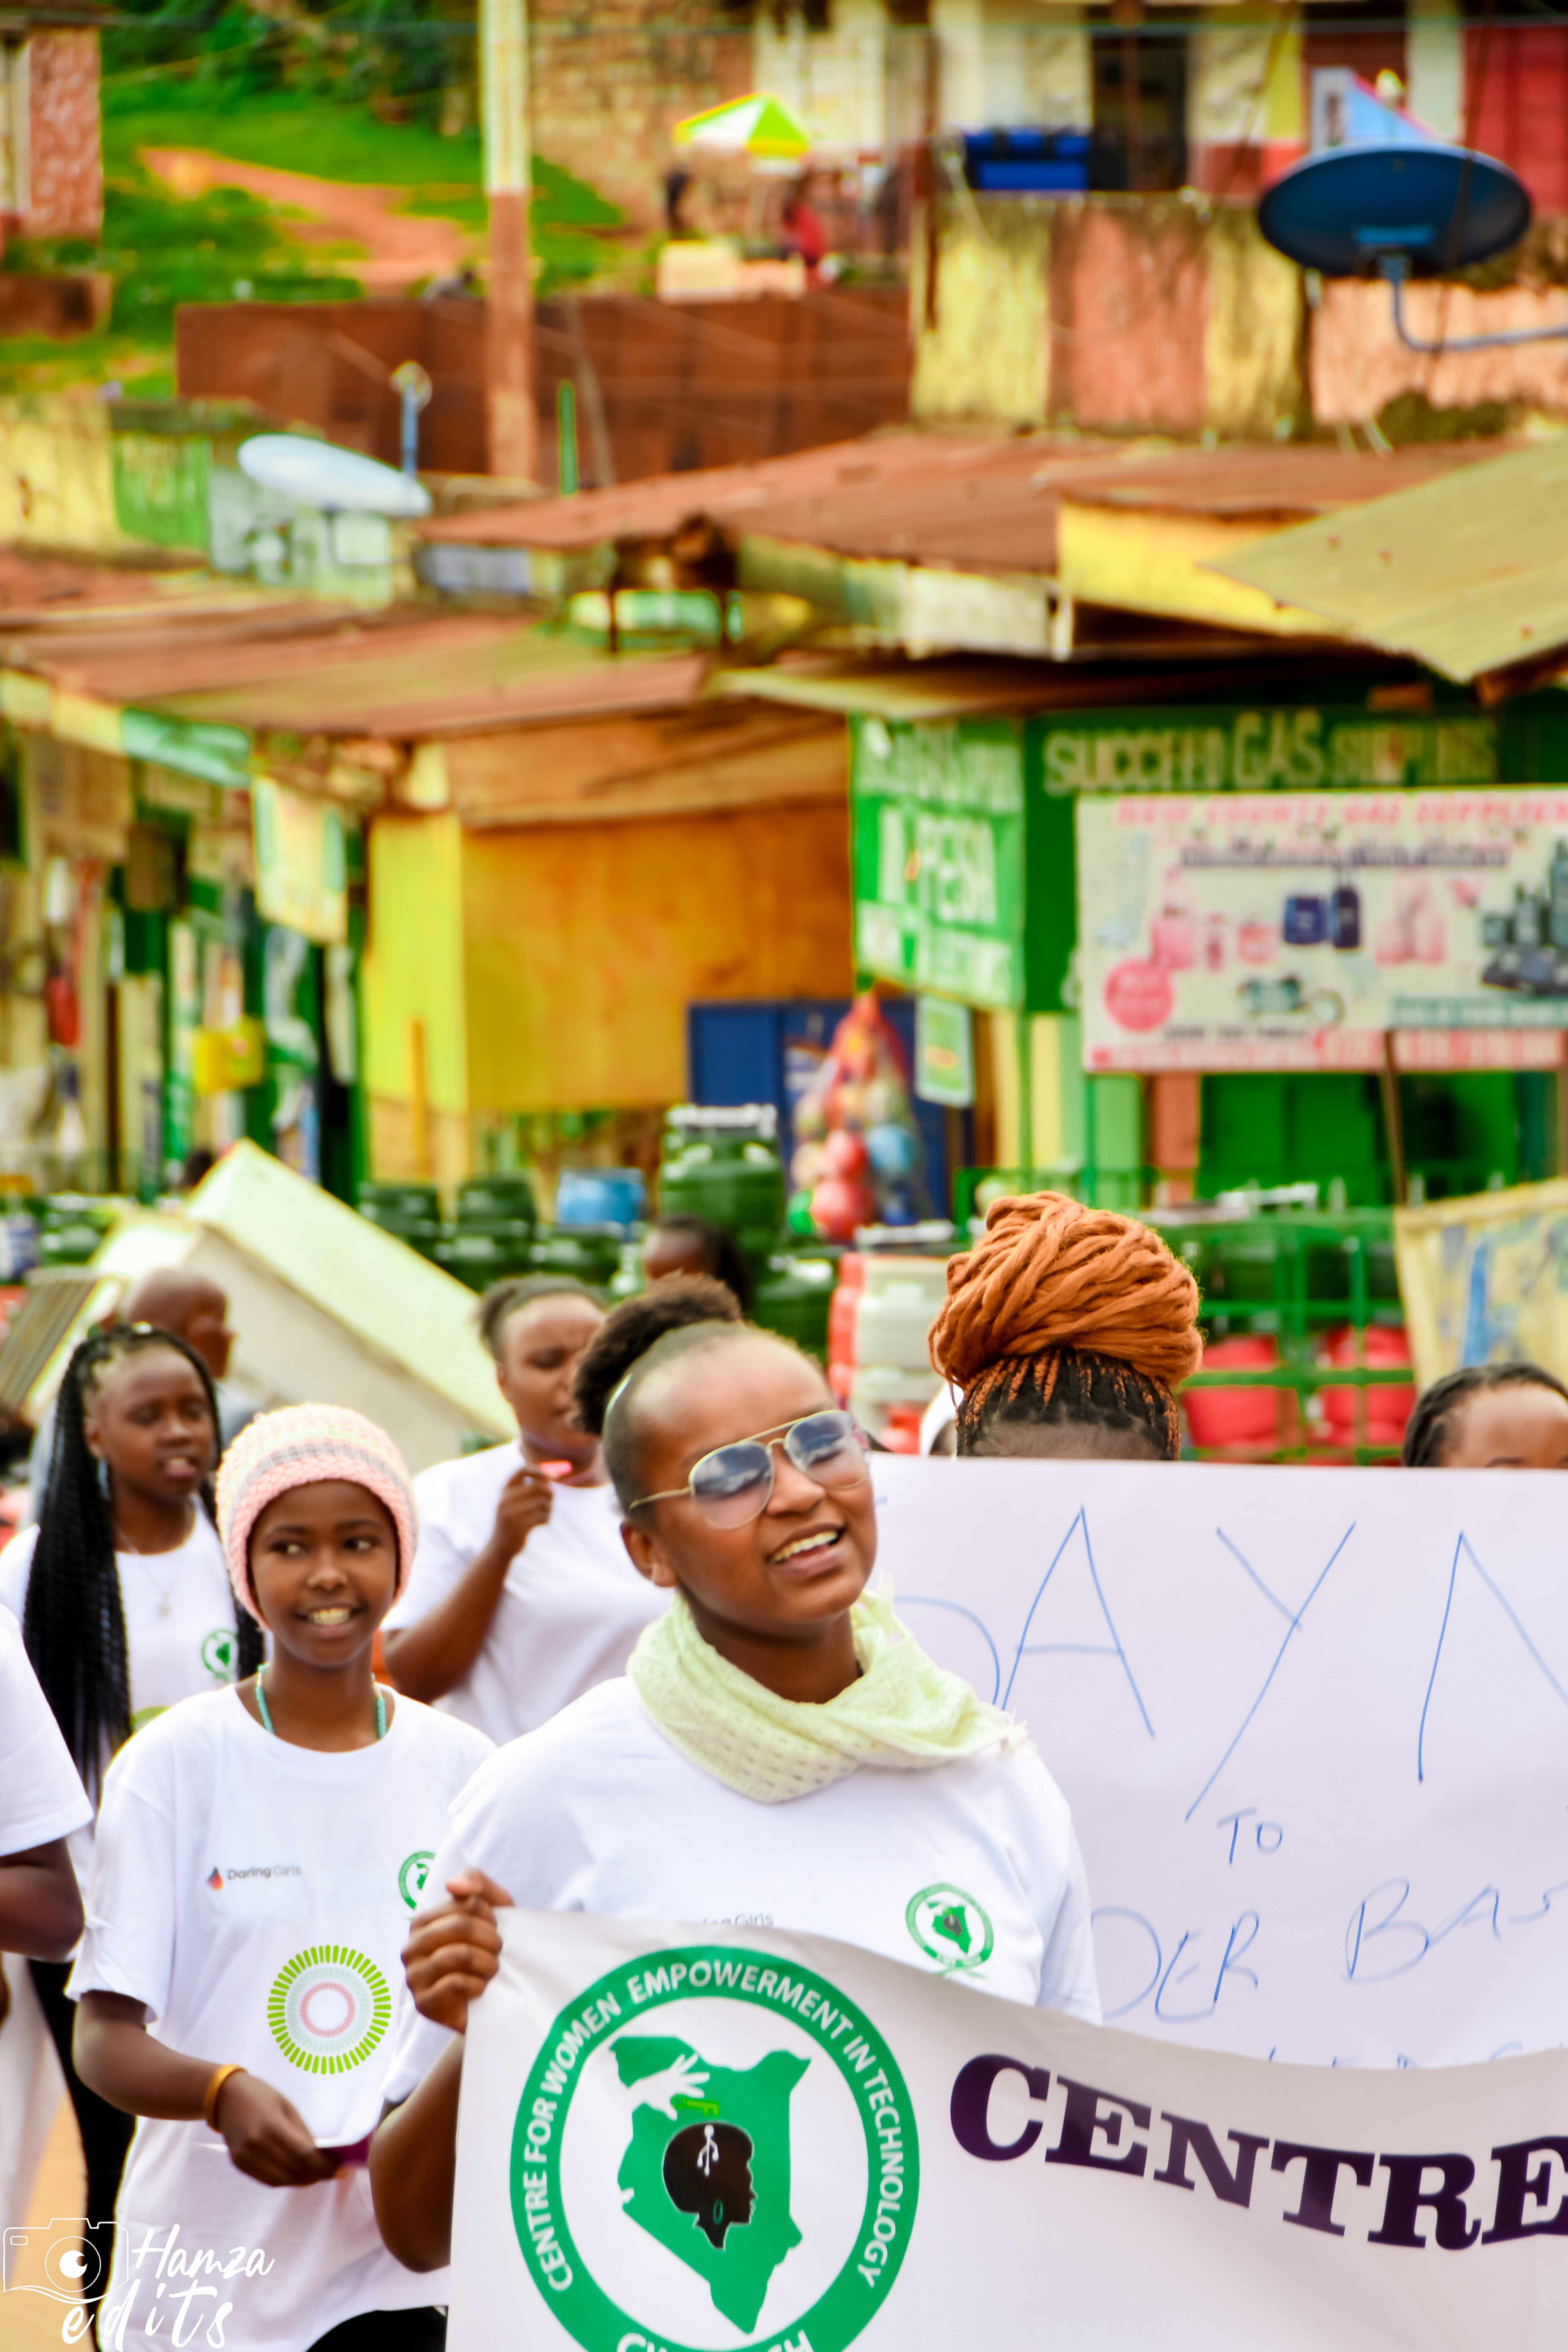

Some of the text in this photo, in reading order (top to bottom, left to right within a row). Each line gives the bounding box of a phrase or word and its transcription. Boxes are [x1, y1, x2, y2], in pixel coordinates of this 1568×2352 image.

[1233, 710, 1325, 787] GAS
[228, 1864, 301, 1880] Daring Girls
[1217, 1806, 1283, 1866] TO
[524, 1959, 905, 2292] CENTRE FOR WOMEN EMPOWERMENT IN TECHNOLOGY
[950, 2053, 1568, 2251] CENTRE
